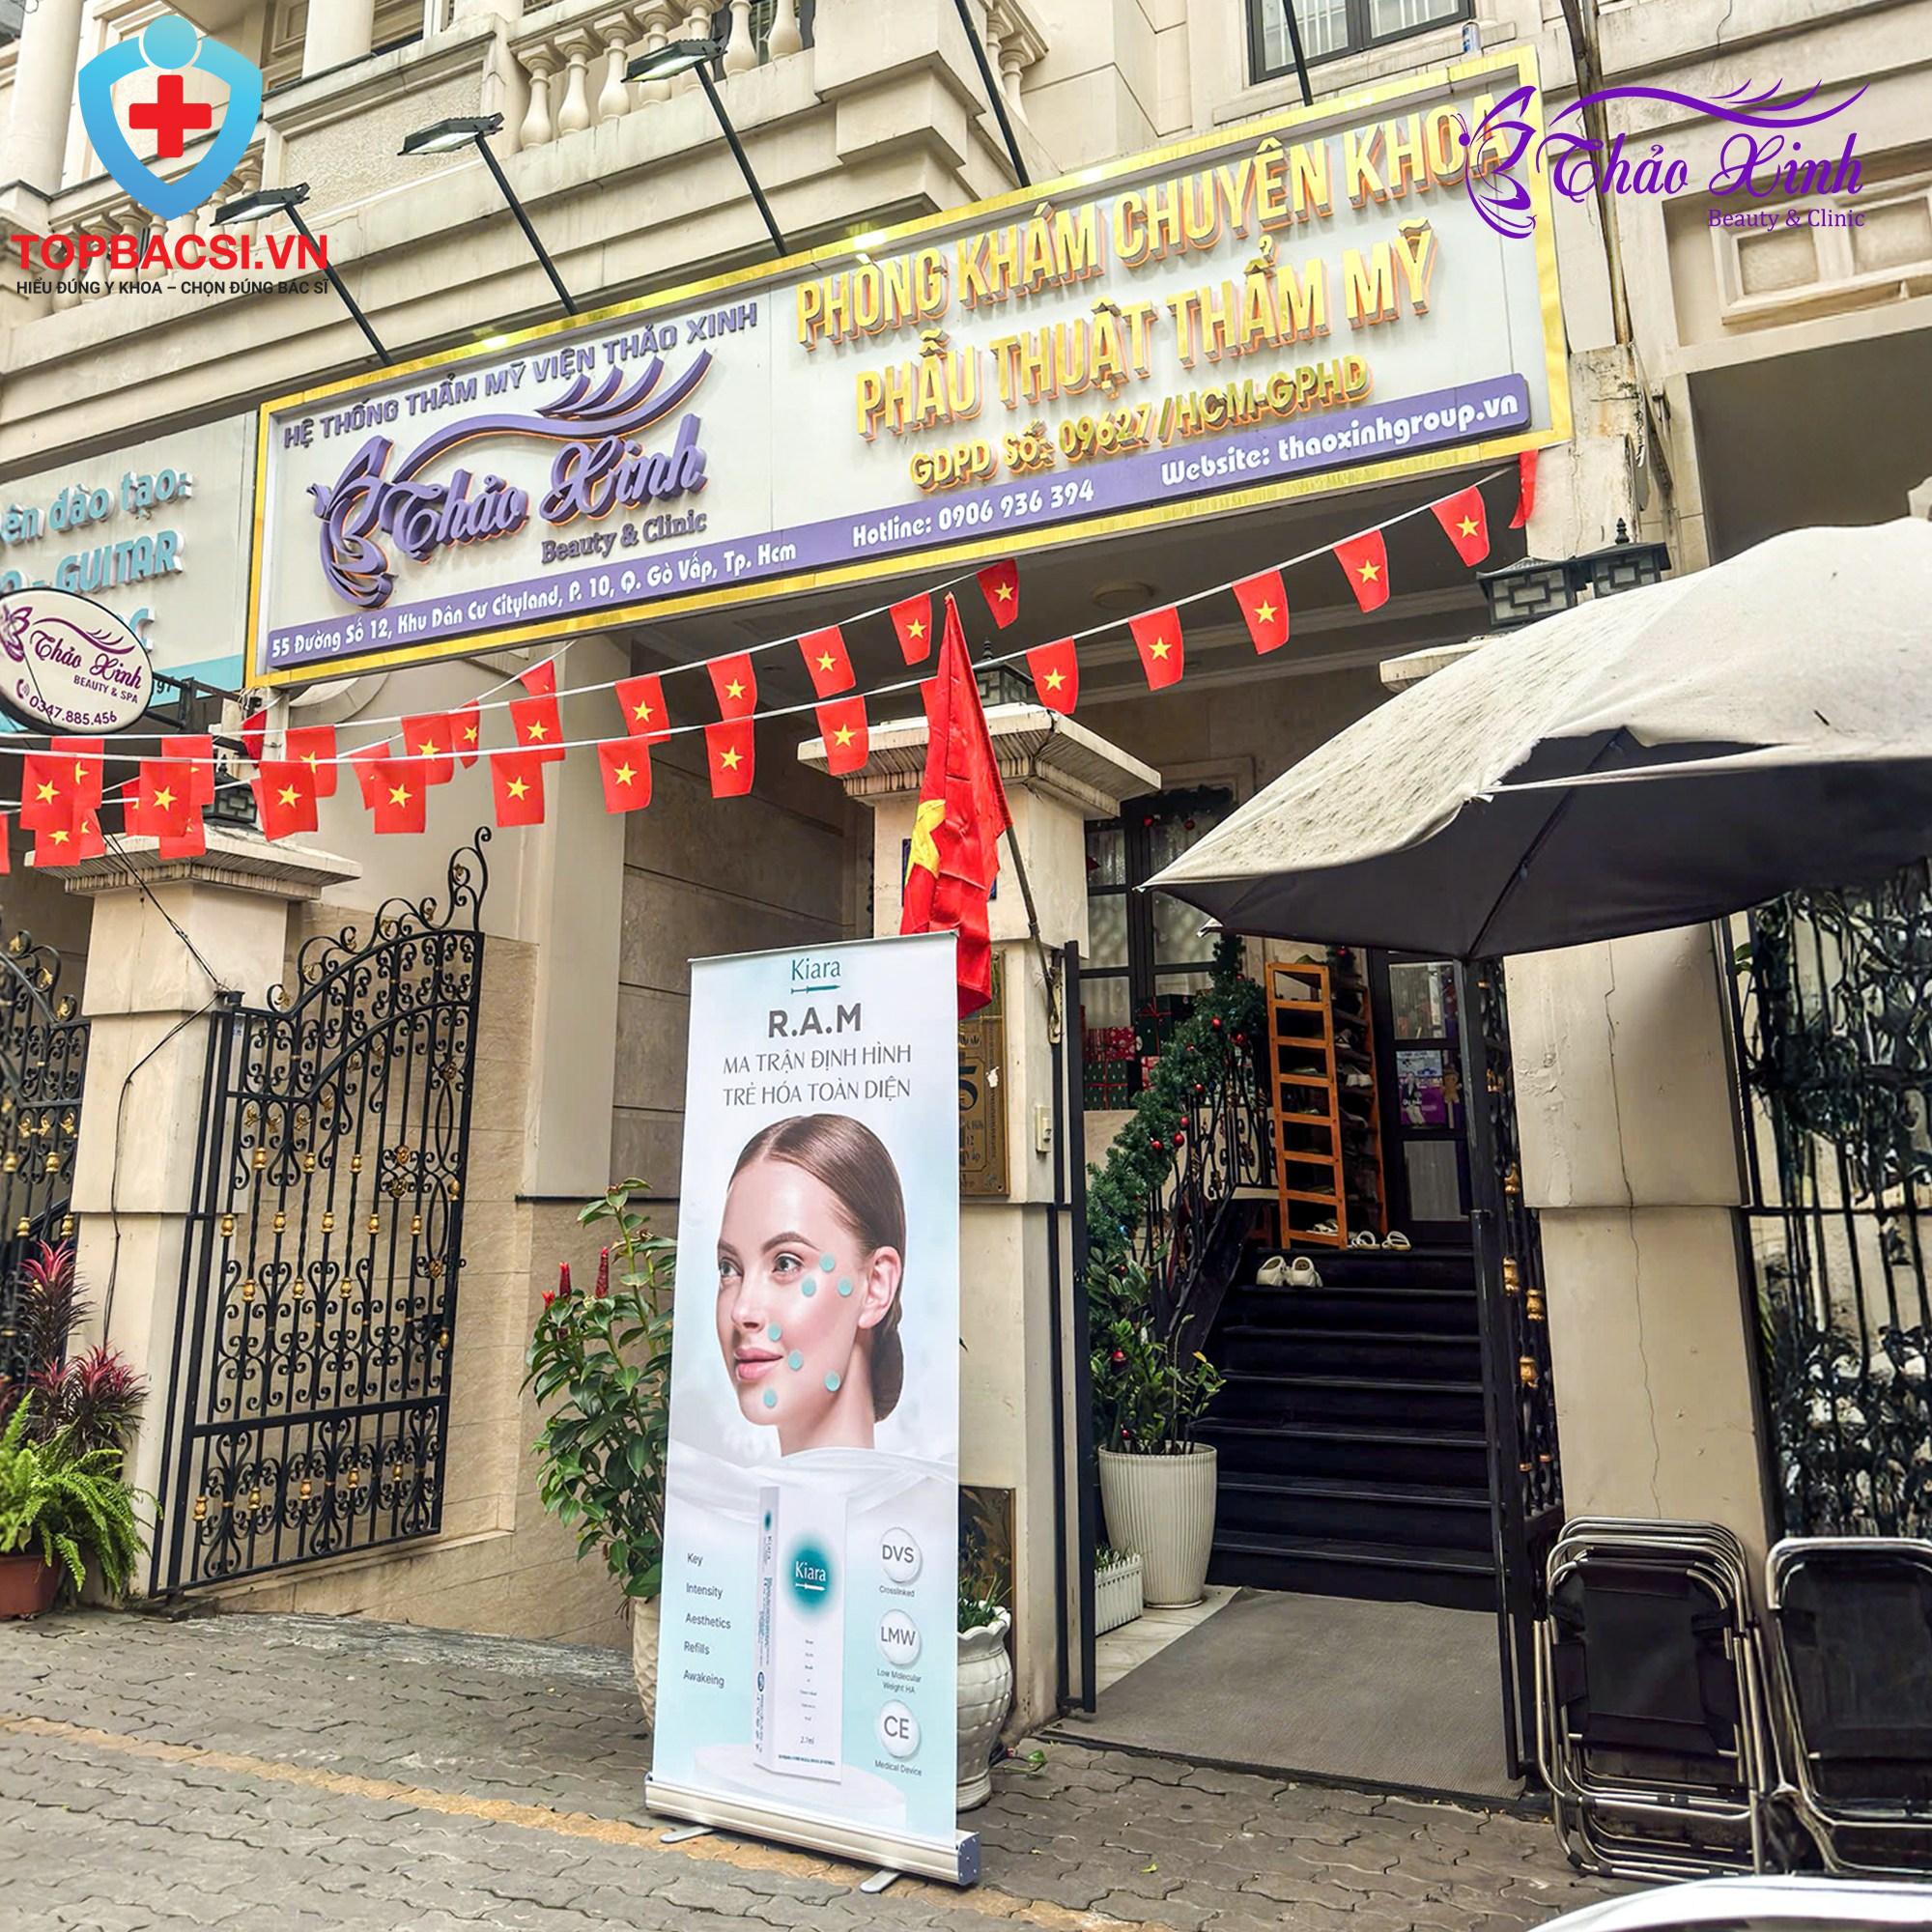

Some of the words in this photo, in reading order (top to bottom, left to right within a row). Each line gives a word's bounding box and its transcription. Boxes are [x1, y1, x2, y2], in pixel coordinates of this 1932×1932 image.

[796, 245, 949, 349] PHÒNG
[957, 201, 1103, 308] KHÁM
[1113, 135, 1332, 267] CHUYÊN
[1343, 92, 1509, 208] KHOA
[857, 327, 982, 441] PHẪU
[989, 295, 1158, 410] THUẬT
[1167, 235, 1330, 370] THẨM
[1343, 216, 1437, 329] MỸ
[283, 416, 315, 449] HỆ
[320, 397, 399, 439] THỐNG
[405, 372, 477, 416] THẨM
[485, 360, 527, 396] MỸ
[532, 346, 595, 384] VIỆN
[602, 324, 678, 364] THẢO
[687, 301, 758, 344] XINH
[49, 484, 115, 532] đào
[121, 469, 193, 522] tạo:
[381, 469, 529, 563] Thảo
[538, 413, 709, 527] Xinh
[271, 637, 289, 658] 55
[294, 629, 342, 654] Đường
[345, 616, 364, 644] Số
[369, 617, 392, 640] 12,
[397, 614, 427, 635] Khu
[432, 604, 463, 628] Dân
[468, 601, 488, 620] Cư
[492, 583, 563, 617] Cityland,
[568, 580, 582, 603] P.
[588, 576, 614, 599] 10,
[646, 561, 674, 586] Gò
[679, 550, 718, 582] Vấp,
[723, 550, 752, 577] Tp.
[757, 542, 797, 566] Hcm
[852, 515, 932, 548] Hotline:
[938, 499, 994, 530] 0906
[1000, 489, 1043, 519] 936
[1049, 478, 1095, 509] 394
[1160, 444, 1271, 487] Website:
[1277, 393, 1520, 464] thaoxinhgroup.vn
[541, 529, 617, 564] Beauty
[620, 523, 639, 548] &
[642, 509, 708, 543] Clinic
[56, 529, 185, 594] GUITAR
[30, 629, 83, 669] Thảo
[89, 652, 143, 690] Xinh
[73, 673, 109, 696] BEAUTY
[111, 687, 118, 697] &
[120, 690, 139, 704] SPA
[29, 695, 118, 725] 0347.885.456
[791, 957, 841, 980] Kiara
[768, 1002, 862, 1038] R.A.M
[723, 1056, 751, 1074] MA
[755, 1048, 806, 1074] TRẬN
[810, 1047, 857, 1071] ĐỊNH
[862, 1041, 912, 1065] HÌNH
[723, 1081, 757, 1107] TRẺ
[762, 1080, 803, 1104] HÓA
[808, 1077, 860, 1102] TOÀN
[865, 1074, 911, 1102] DIỆN
[687, 1552, 703, 1567] Key
[881, 1544, 915, 1564] DVS
[795, 1560, 827, 1582] Kiara
[685, 1581, 724, 1601] Intensity
[684, 1612, 732, 1630] Aesthetics
[683, 1640, 711, 1656] Refills
[880, 1626, 916, 1647] LMW
[682, 1669, 725, 1690] Awakeing
[876, 1668, 890, 1678] Low
[882, 1682, 904, 1693] Weight
[905, 1686, 916, 1694] HA
[883, 1715, 910, 1740] CE
[874, 1759, 899, 1773] Medical
[900, 1764, 923, 1777] Device
